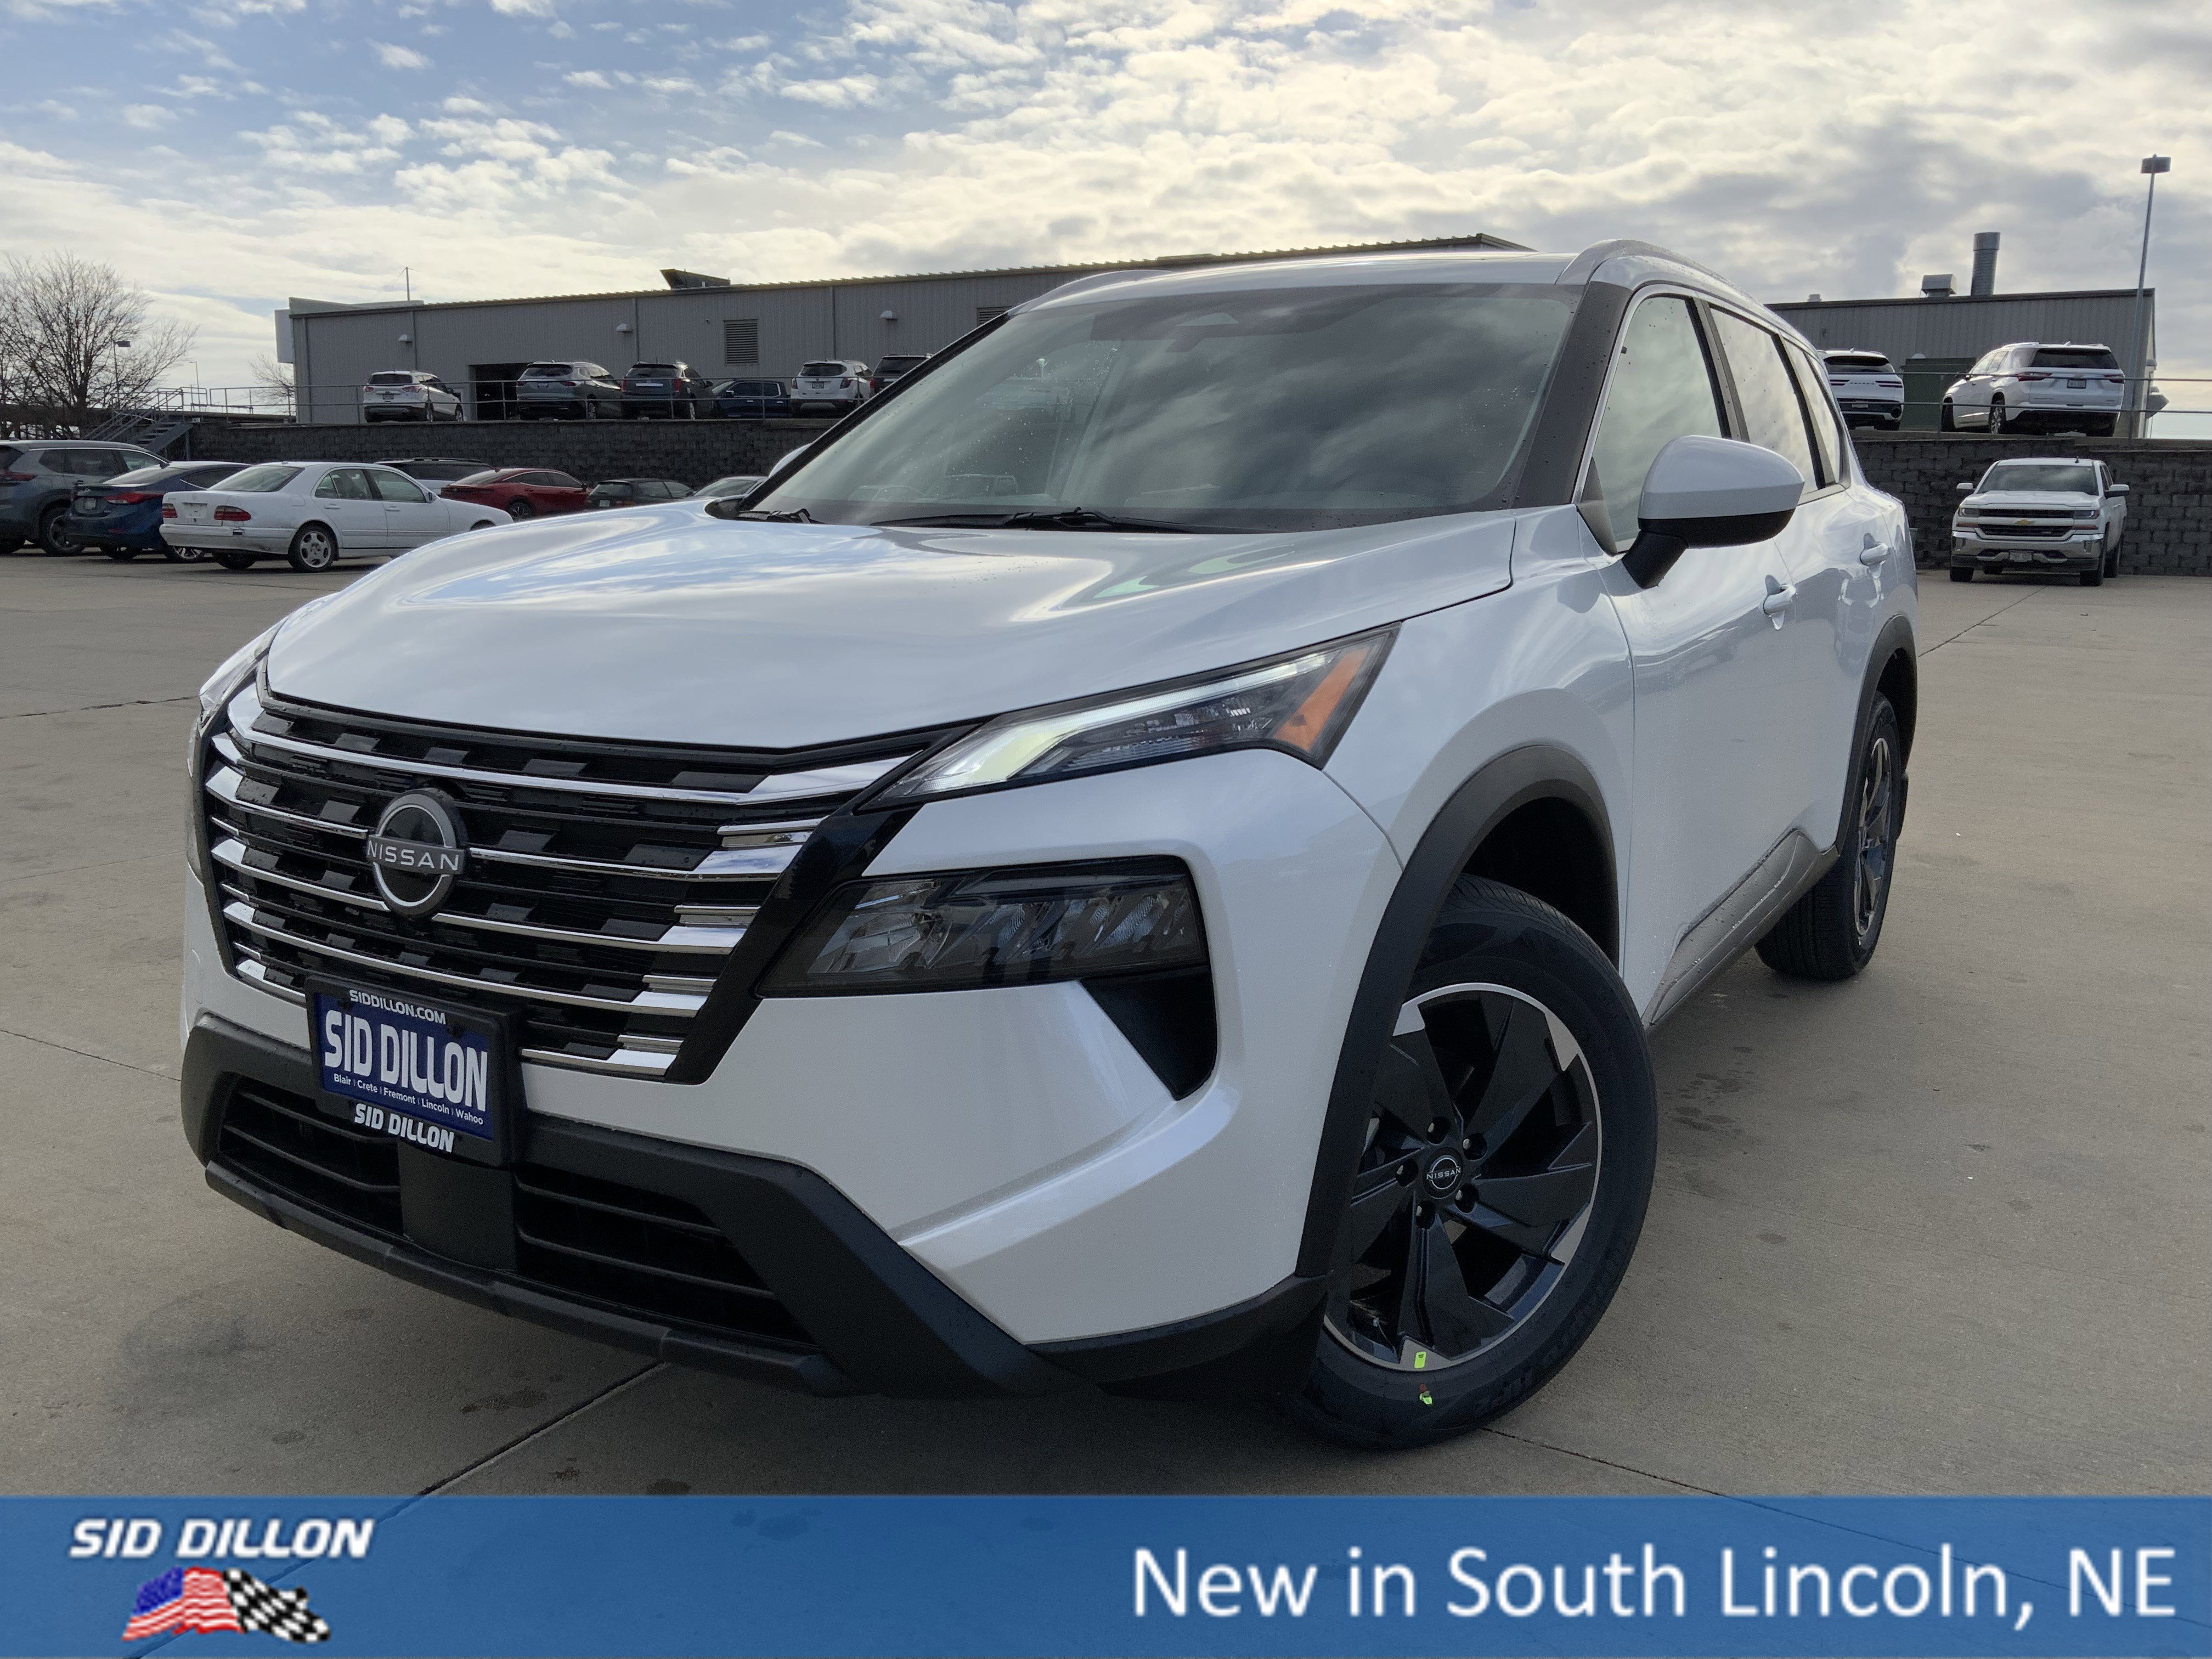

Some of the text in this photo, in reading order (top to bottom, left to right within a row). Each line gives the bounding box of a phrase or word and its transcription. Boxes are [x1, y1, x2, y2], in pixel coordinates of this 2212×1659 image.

[367, 840, 459, 871] NISSAN
[349, 989, 446, 1025] SIDDILLON.COM
[324, 1009, 488, 1111] SID DILLON
[334, 1073, 483, 1126] Blair Crete Fremont Lincoln Wahoo
[354, 1103, 455, 1153] SID DILLON
[1426, 1167, 1461, 1180] NISSAN
